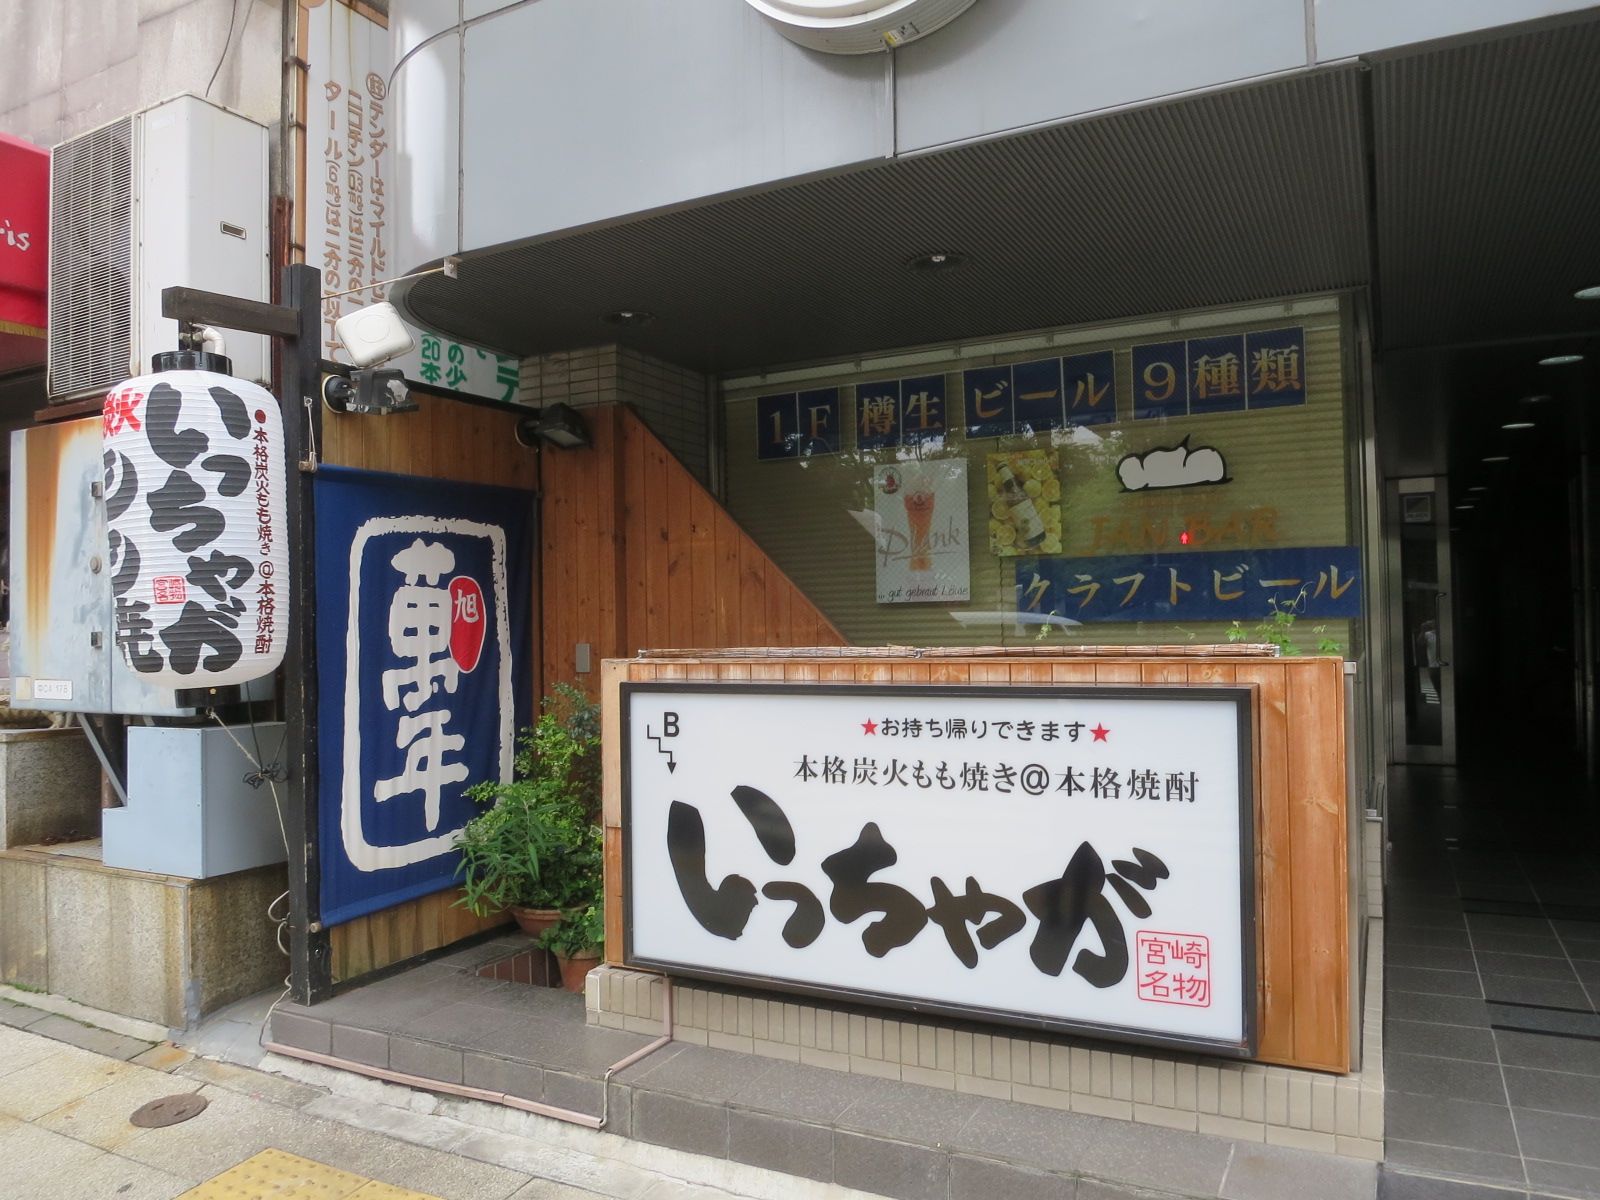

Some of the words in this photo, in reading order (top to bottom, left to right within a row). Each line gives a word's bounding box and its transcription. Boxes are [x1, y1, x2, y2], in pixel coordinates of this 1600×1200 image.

[0, 218, 31, 252] is
[769, 404, 831, 445] 1F
[858, 391, 943, 438] 樽生
[974, 371, 1111, 419] ビール
[1142, 343, 1302, 401] 9種類
[145, 382, 255, 675] いっちゃが
[1023, 563, 1356, 612] クラフトビール
[453, 589, 480, 624] 旭
[664, 711, 680, 738] B
[880, 716, 1087, 744] お持ち帰りできます
[792, 753, 1201, 804] 本格炭火もも焼き@本格焼酎
[666, 784, 1171, 989] いっちゃが
[1139, 935, 1207, 970] 宮崎
[1139, 969, 1208, 1004] 名物
